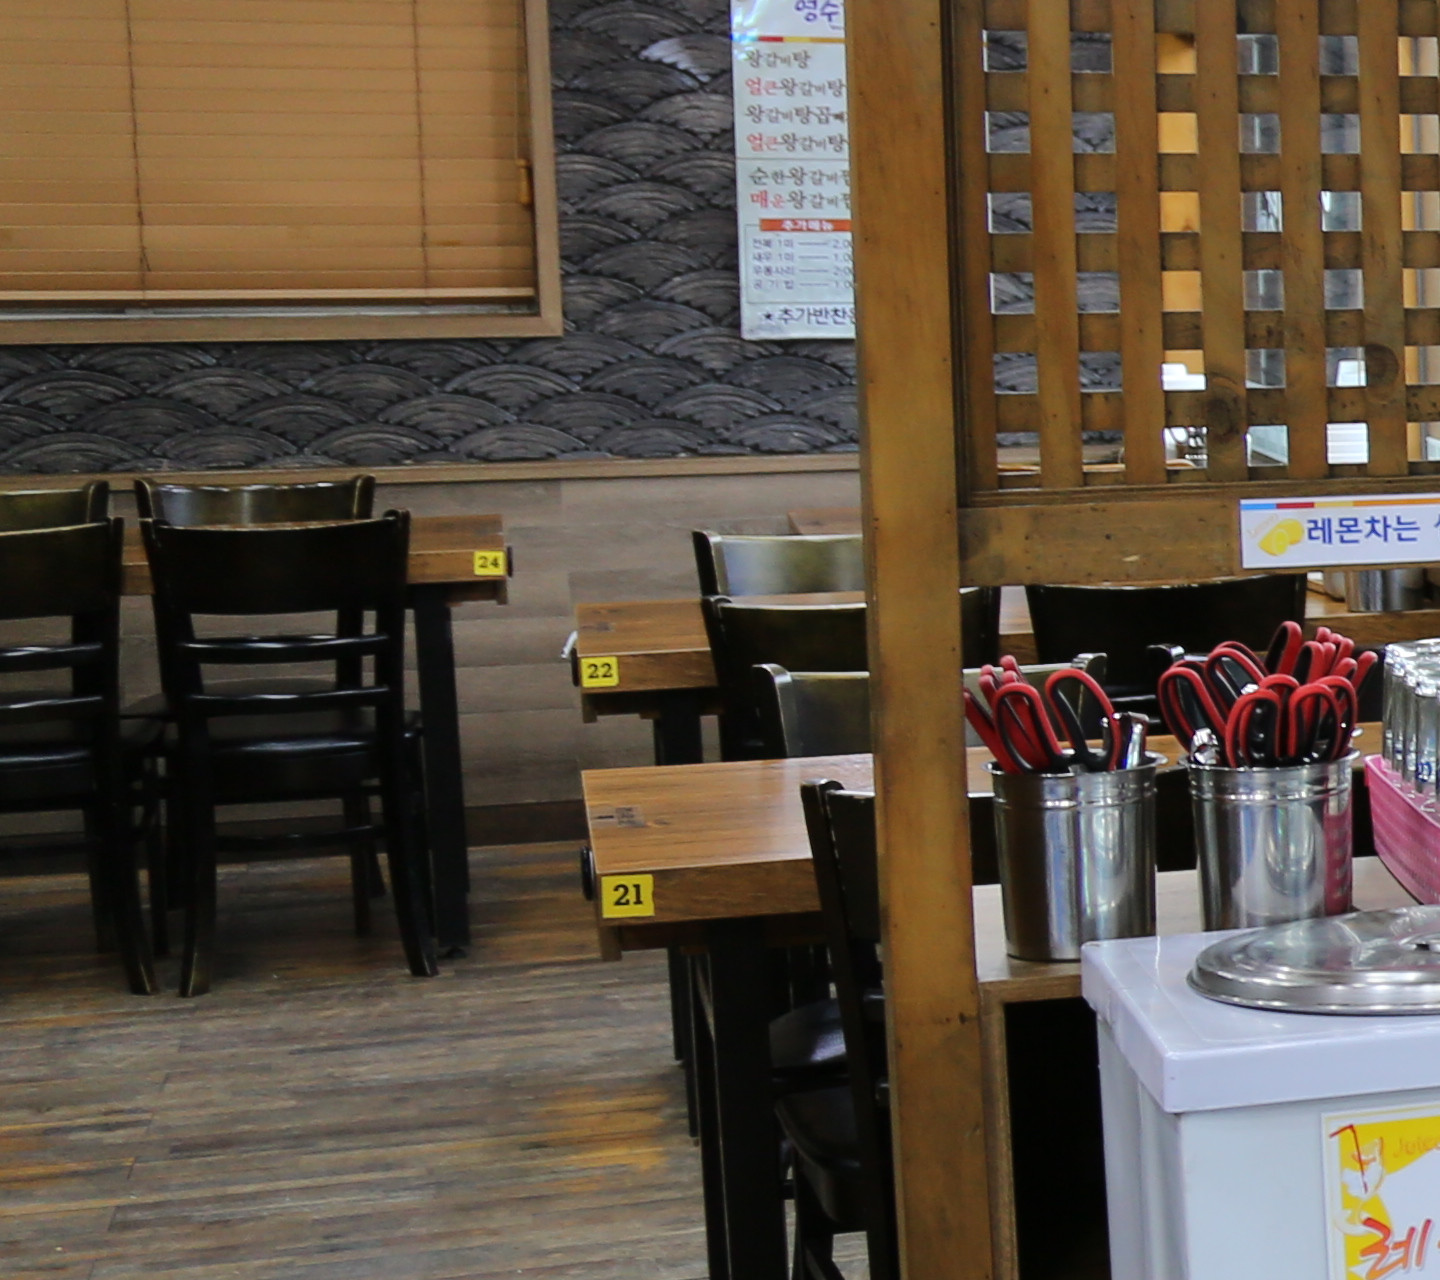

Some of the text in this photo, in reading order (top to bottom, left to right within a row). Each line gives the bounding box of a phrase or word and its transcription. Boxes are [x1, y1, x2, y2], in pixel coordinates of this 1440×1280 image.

[1307, 515, 1420, 545] 레몬차는
[478, 556, 499, 568] 24
[587, 663, 614, 679] 22
[613, 884, 643, 905] 21
